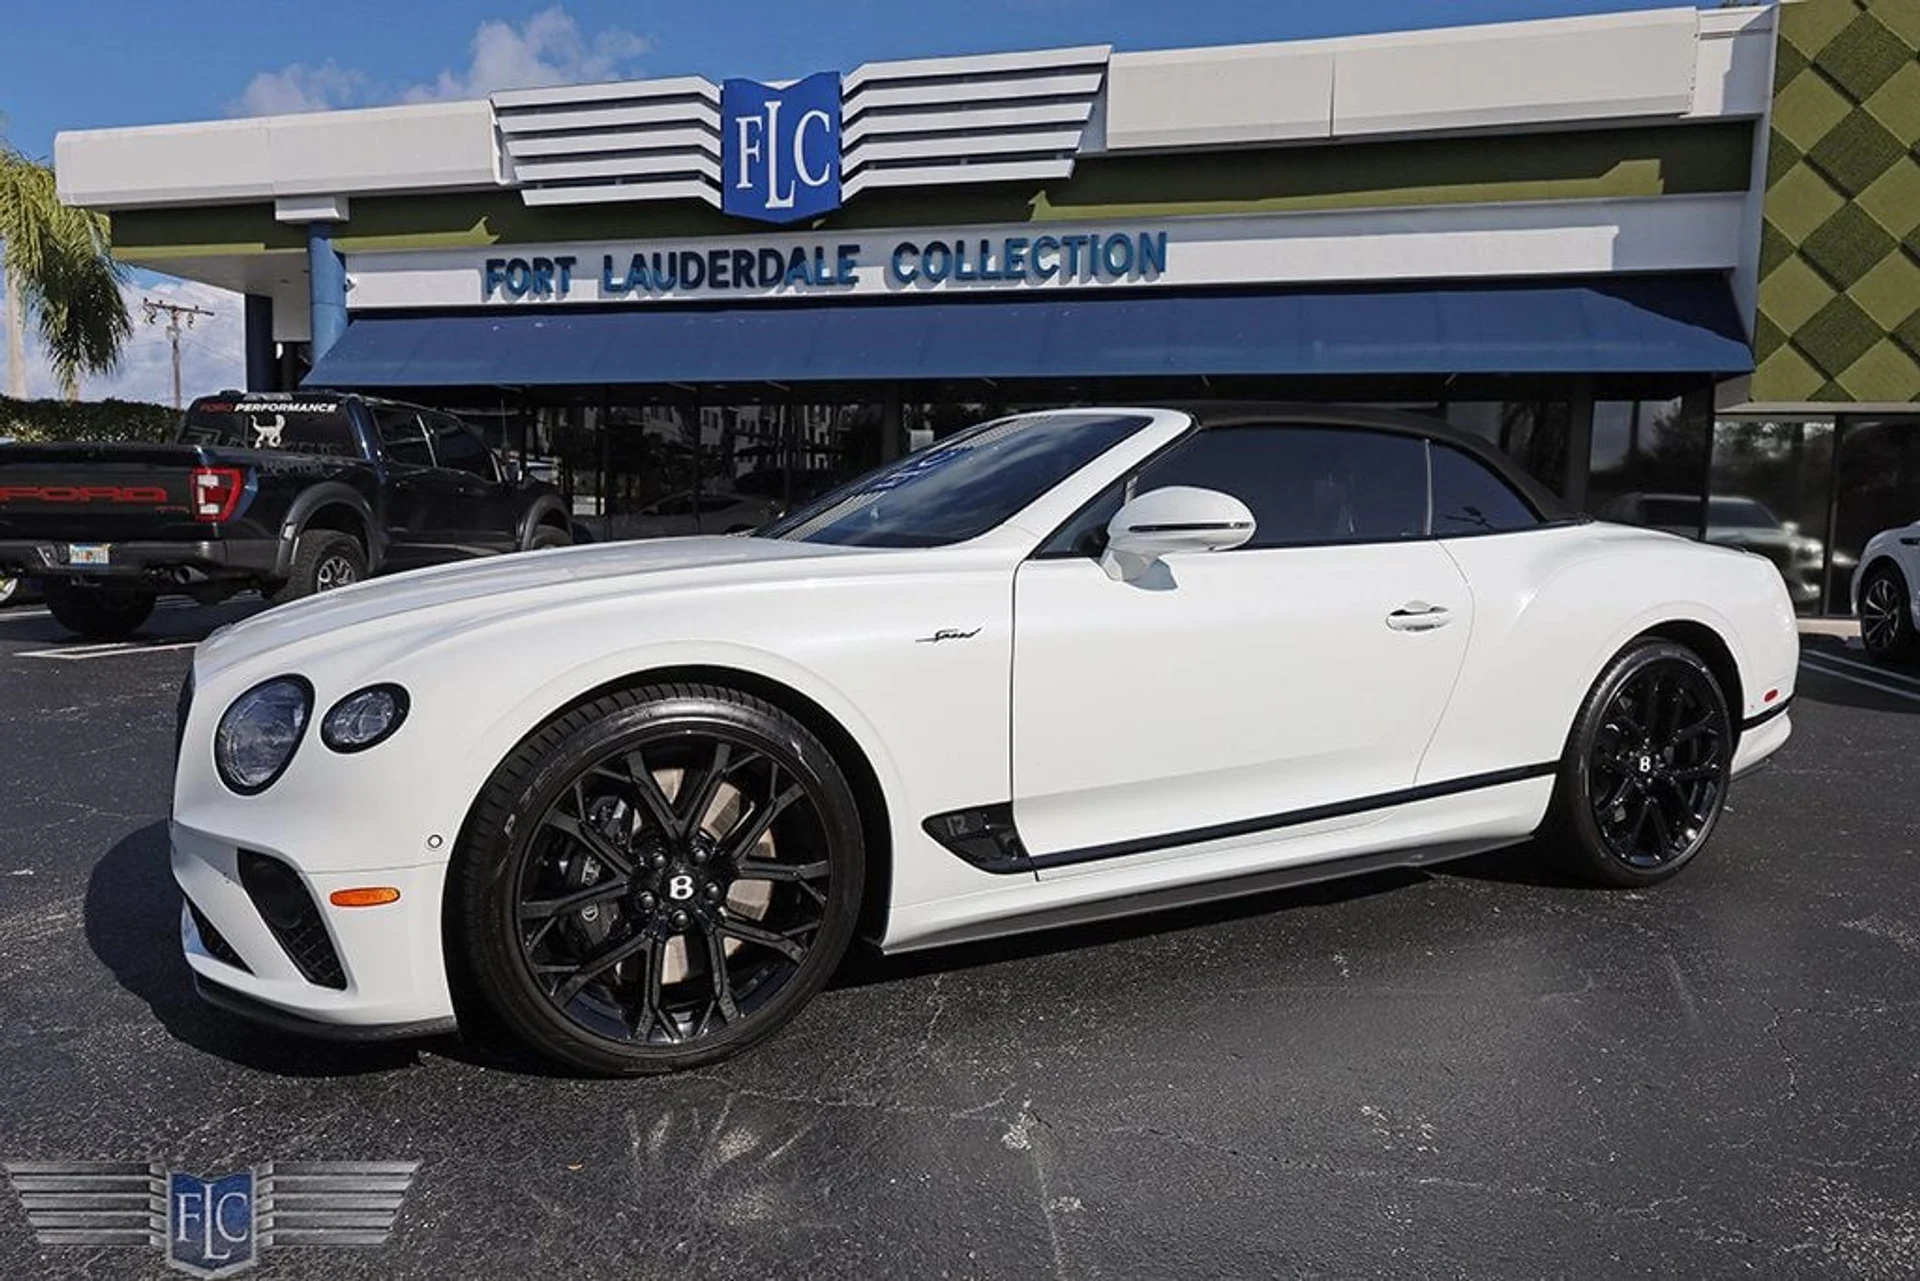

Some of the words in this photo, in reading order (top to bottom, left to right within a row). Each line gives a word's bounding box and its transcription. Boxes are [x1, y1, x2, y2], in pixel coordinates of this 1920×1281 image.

[735, 101, 831, 208] FLC
[485, 256, 577, 296] FORT
[603, 244, 861, 293] LAUDERDALE
[891, 231, 1168, 286] COLLECTION
[234, 402, 337, 413] PERFORMANCE
[669, 875, 694, 900] B
